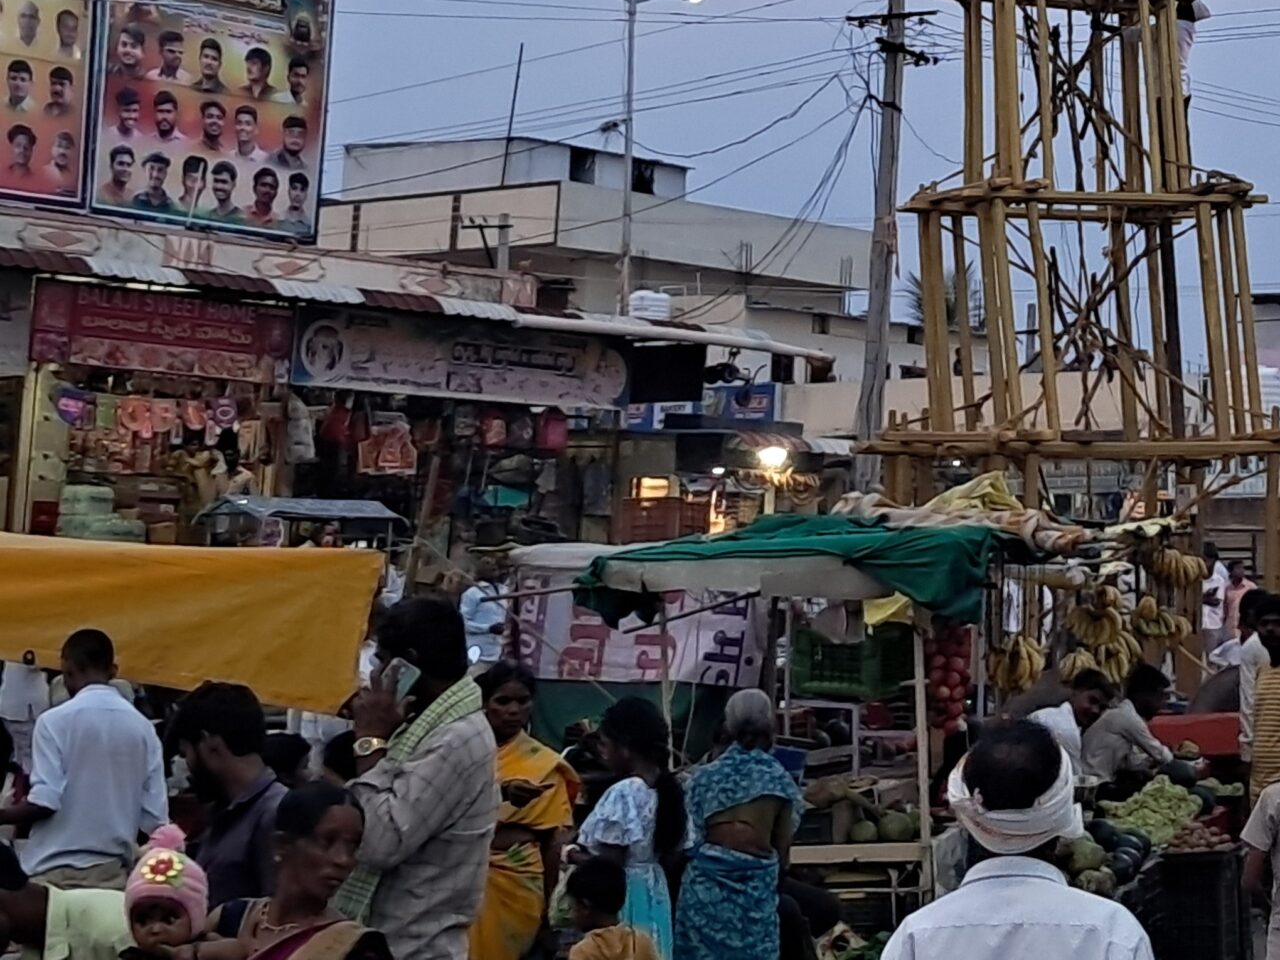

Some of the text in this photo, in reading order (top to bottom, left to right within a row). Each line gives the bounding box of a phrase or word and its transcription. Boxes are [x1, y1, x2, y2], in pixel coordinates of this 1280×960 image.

[78, 286, 256, 324] BALAJI SWEET HOME
